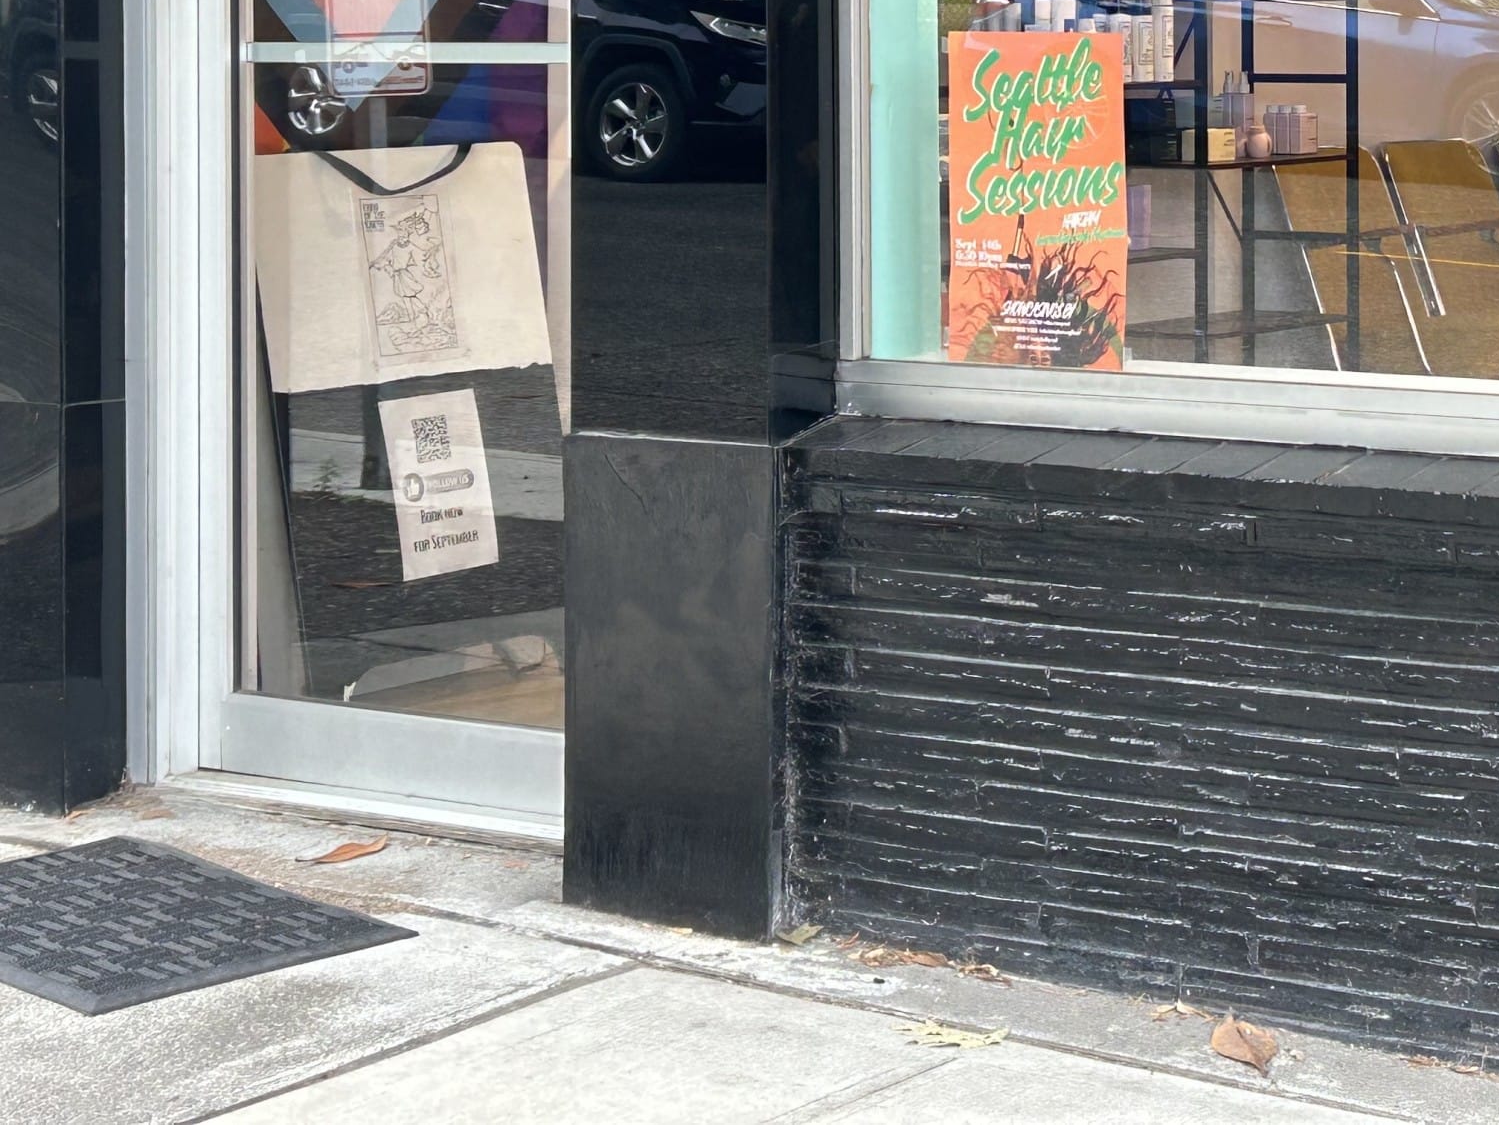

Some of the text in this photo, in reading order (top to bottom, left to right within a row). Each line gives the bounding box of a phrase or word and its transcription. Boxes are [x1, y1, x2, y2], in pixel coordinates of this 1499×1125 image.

[964, 37, 1104, 124] Seattle
[990, 101, 1088, 171] Hair
[957, 149, 1124, 226] Sessions
